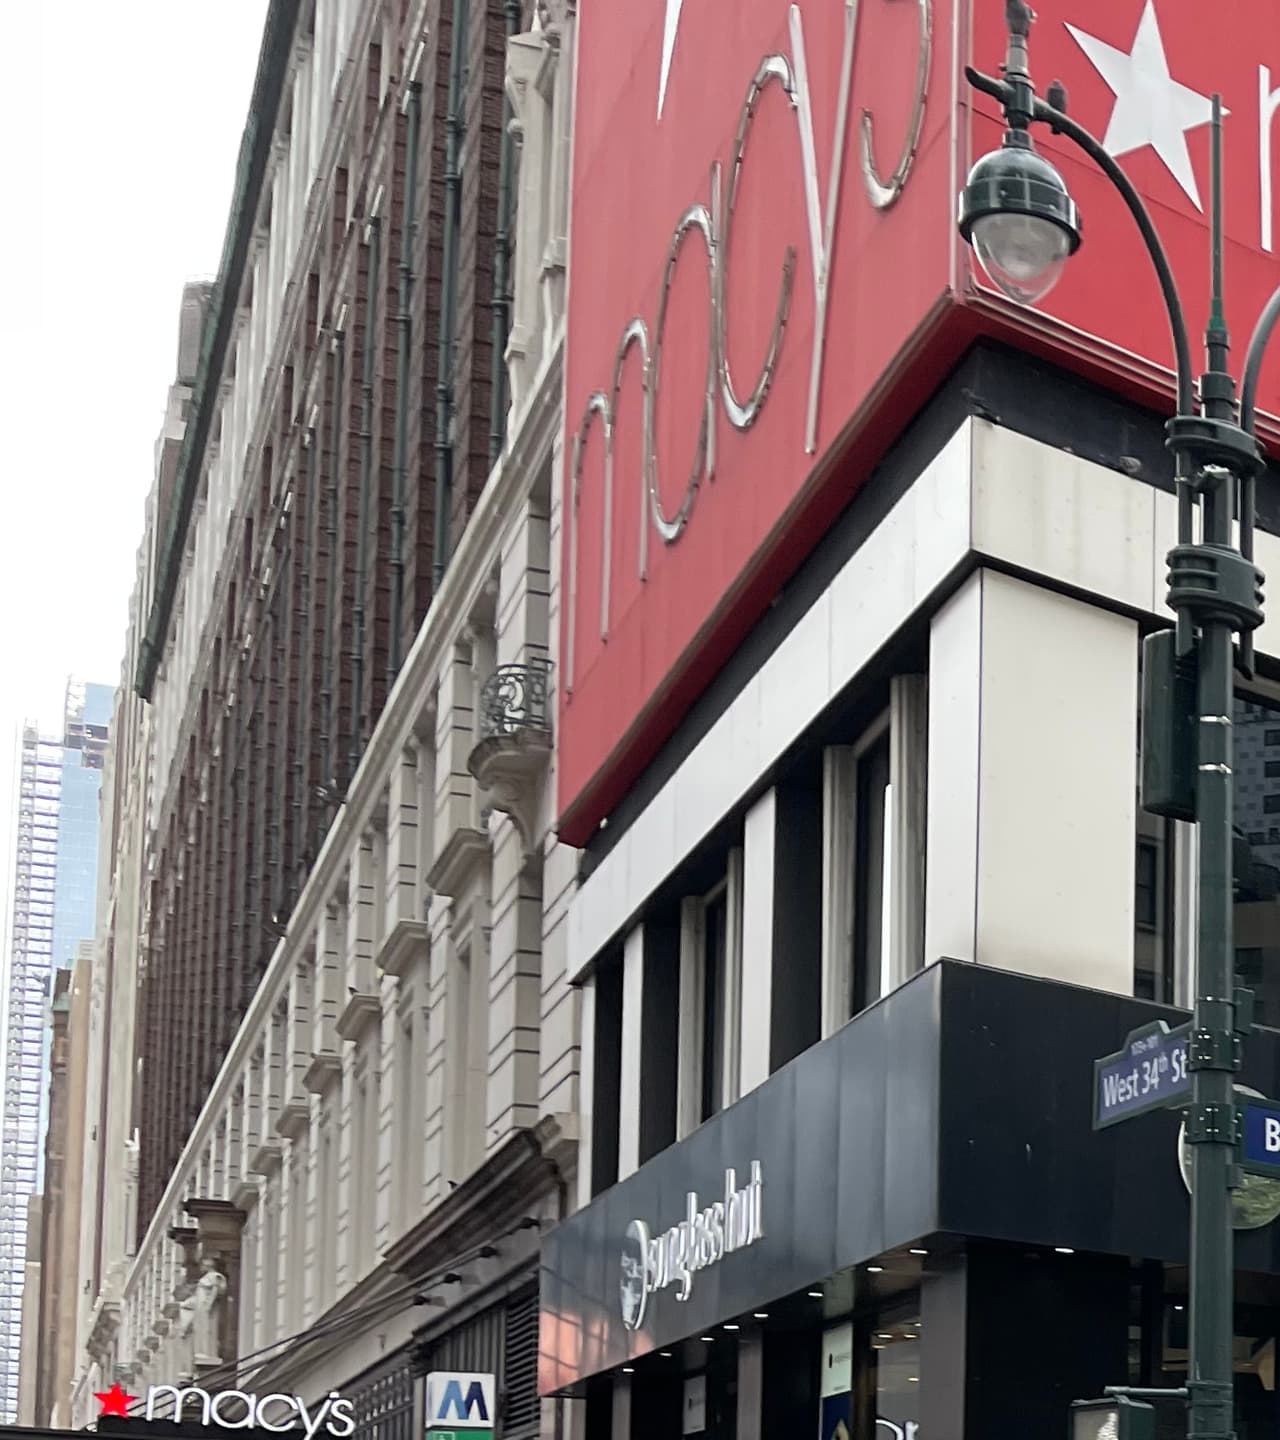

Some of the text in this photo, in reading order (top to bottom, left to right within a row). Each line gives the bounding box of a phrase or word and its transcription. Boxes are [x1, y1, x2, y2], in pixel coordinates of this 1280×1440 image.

[566, 0, 934, 697] macys
[1103, 1047, 1188, 1108] West 34th St
